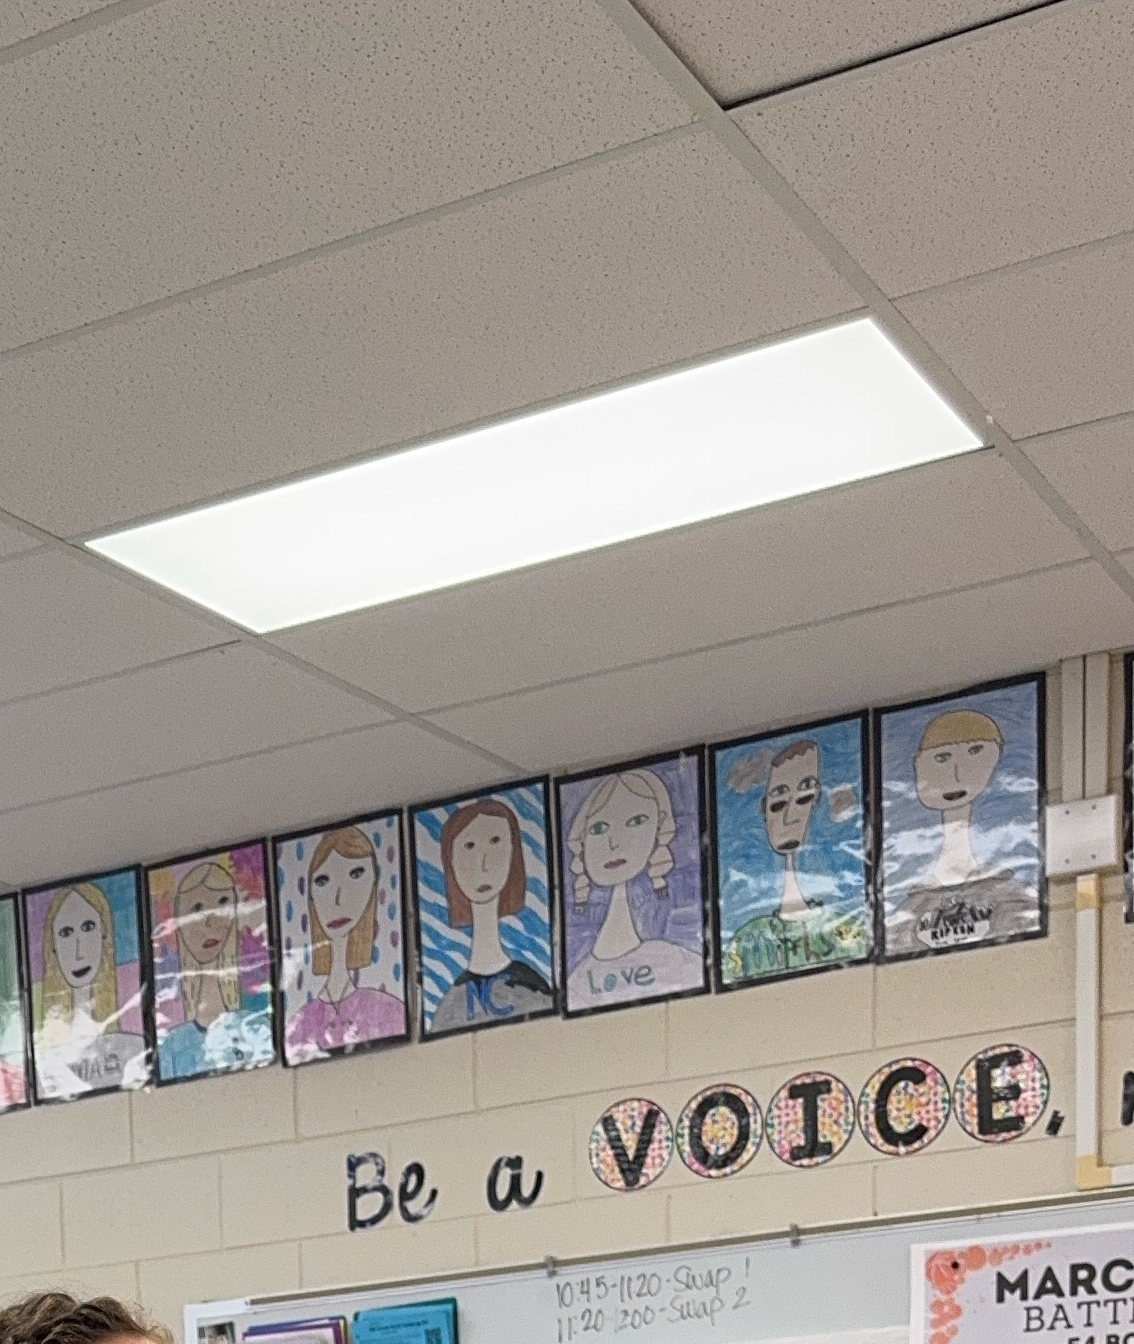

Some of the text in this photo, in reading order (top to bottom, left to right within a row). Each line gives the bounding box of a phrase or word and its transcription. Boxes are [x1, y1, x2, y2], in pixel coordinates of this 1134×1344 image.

[467, 973, 514, 1021] NC
[587, 964, 655, 995] Love
[347, 1151, 438, 1232] Be
[486, 1155, 544, 1212] a
[732, 1286, 750, 1310] 2
[995, 1258, 1134, 1304] MARC
